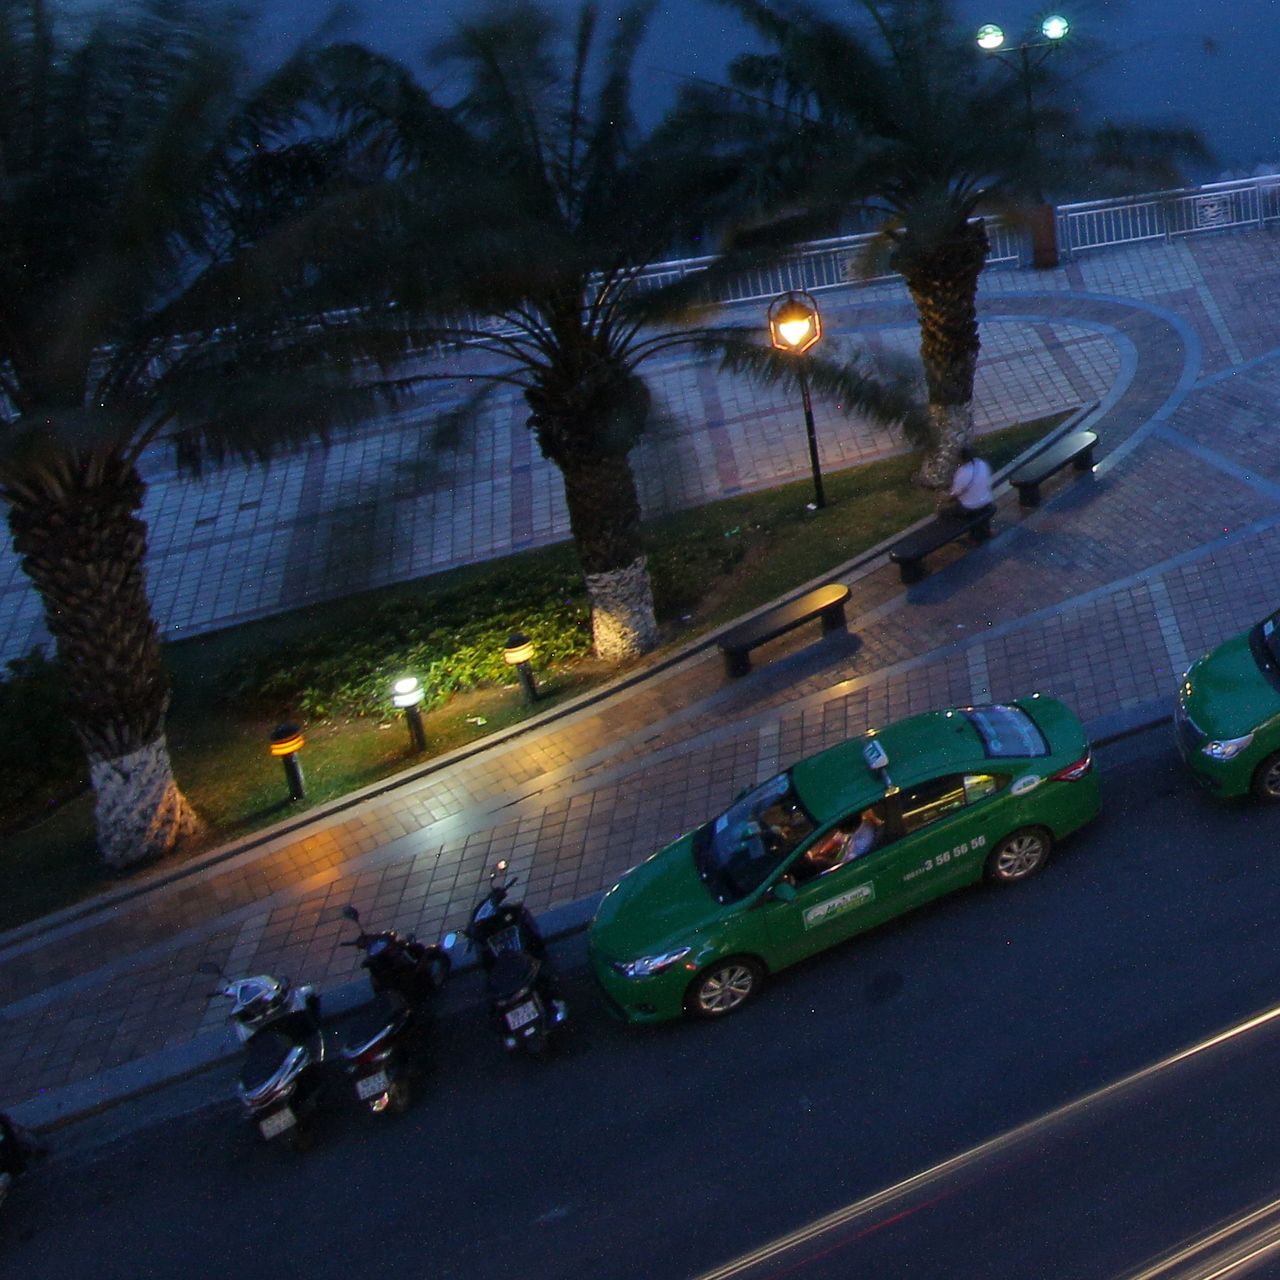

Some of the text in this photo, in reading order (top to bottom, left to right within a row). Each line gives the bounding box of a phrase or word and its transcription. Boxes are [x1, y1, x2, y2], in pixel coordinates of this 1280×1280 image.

[924, 859, 934, 871] 3
[935, 851, 951, 866] 56
[952, 843, 968, 858] 56
[970, 835, 986, 850] 56
